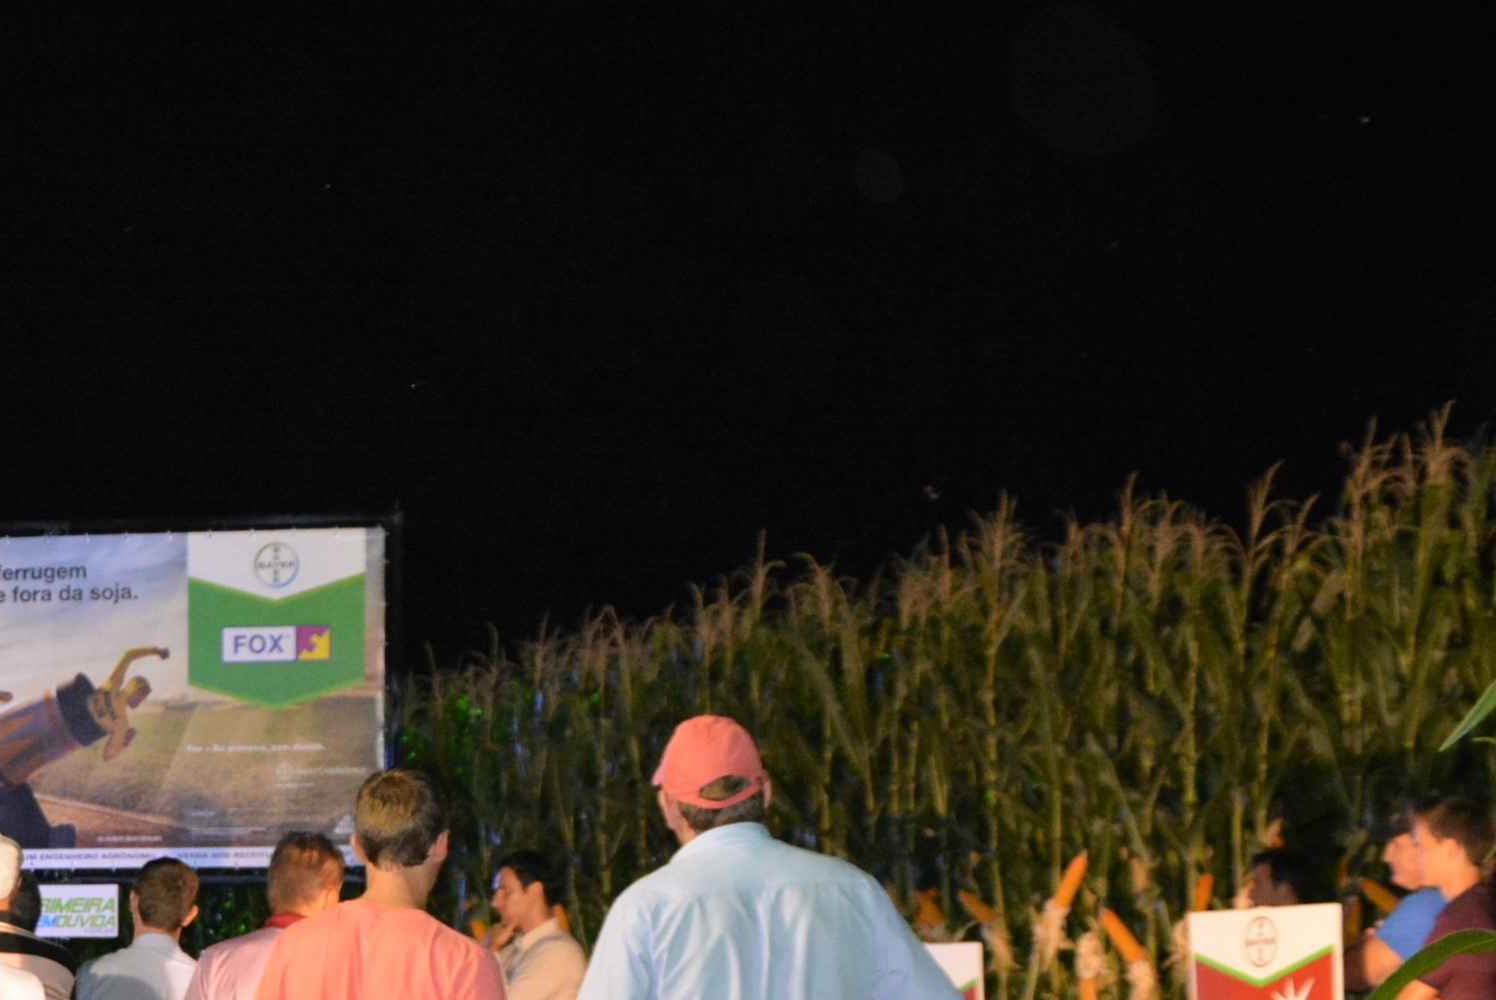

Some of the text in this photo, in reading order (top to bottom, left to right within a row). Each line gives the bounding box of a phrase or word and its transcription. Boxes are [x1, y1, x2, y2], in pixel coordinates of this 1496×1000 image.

[12, 585, 52, 603] fora
[59, 585, 83, 602] da
[90, 584, 138, 603] soja.
[233, 634, 284, 654] FOX
[39, 852, 98, 861] ENGENHEIRO
[100, 850, 156, 860] AGRÔNOMO
[41, 897, 116, 914] RIMEIRA
